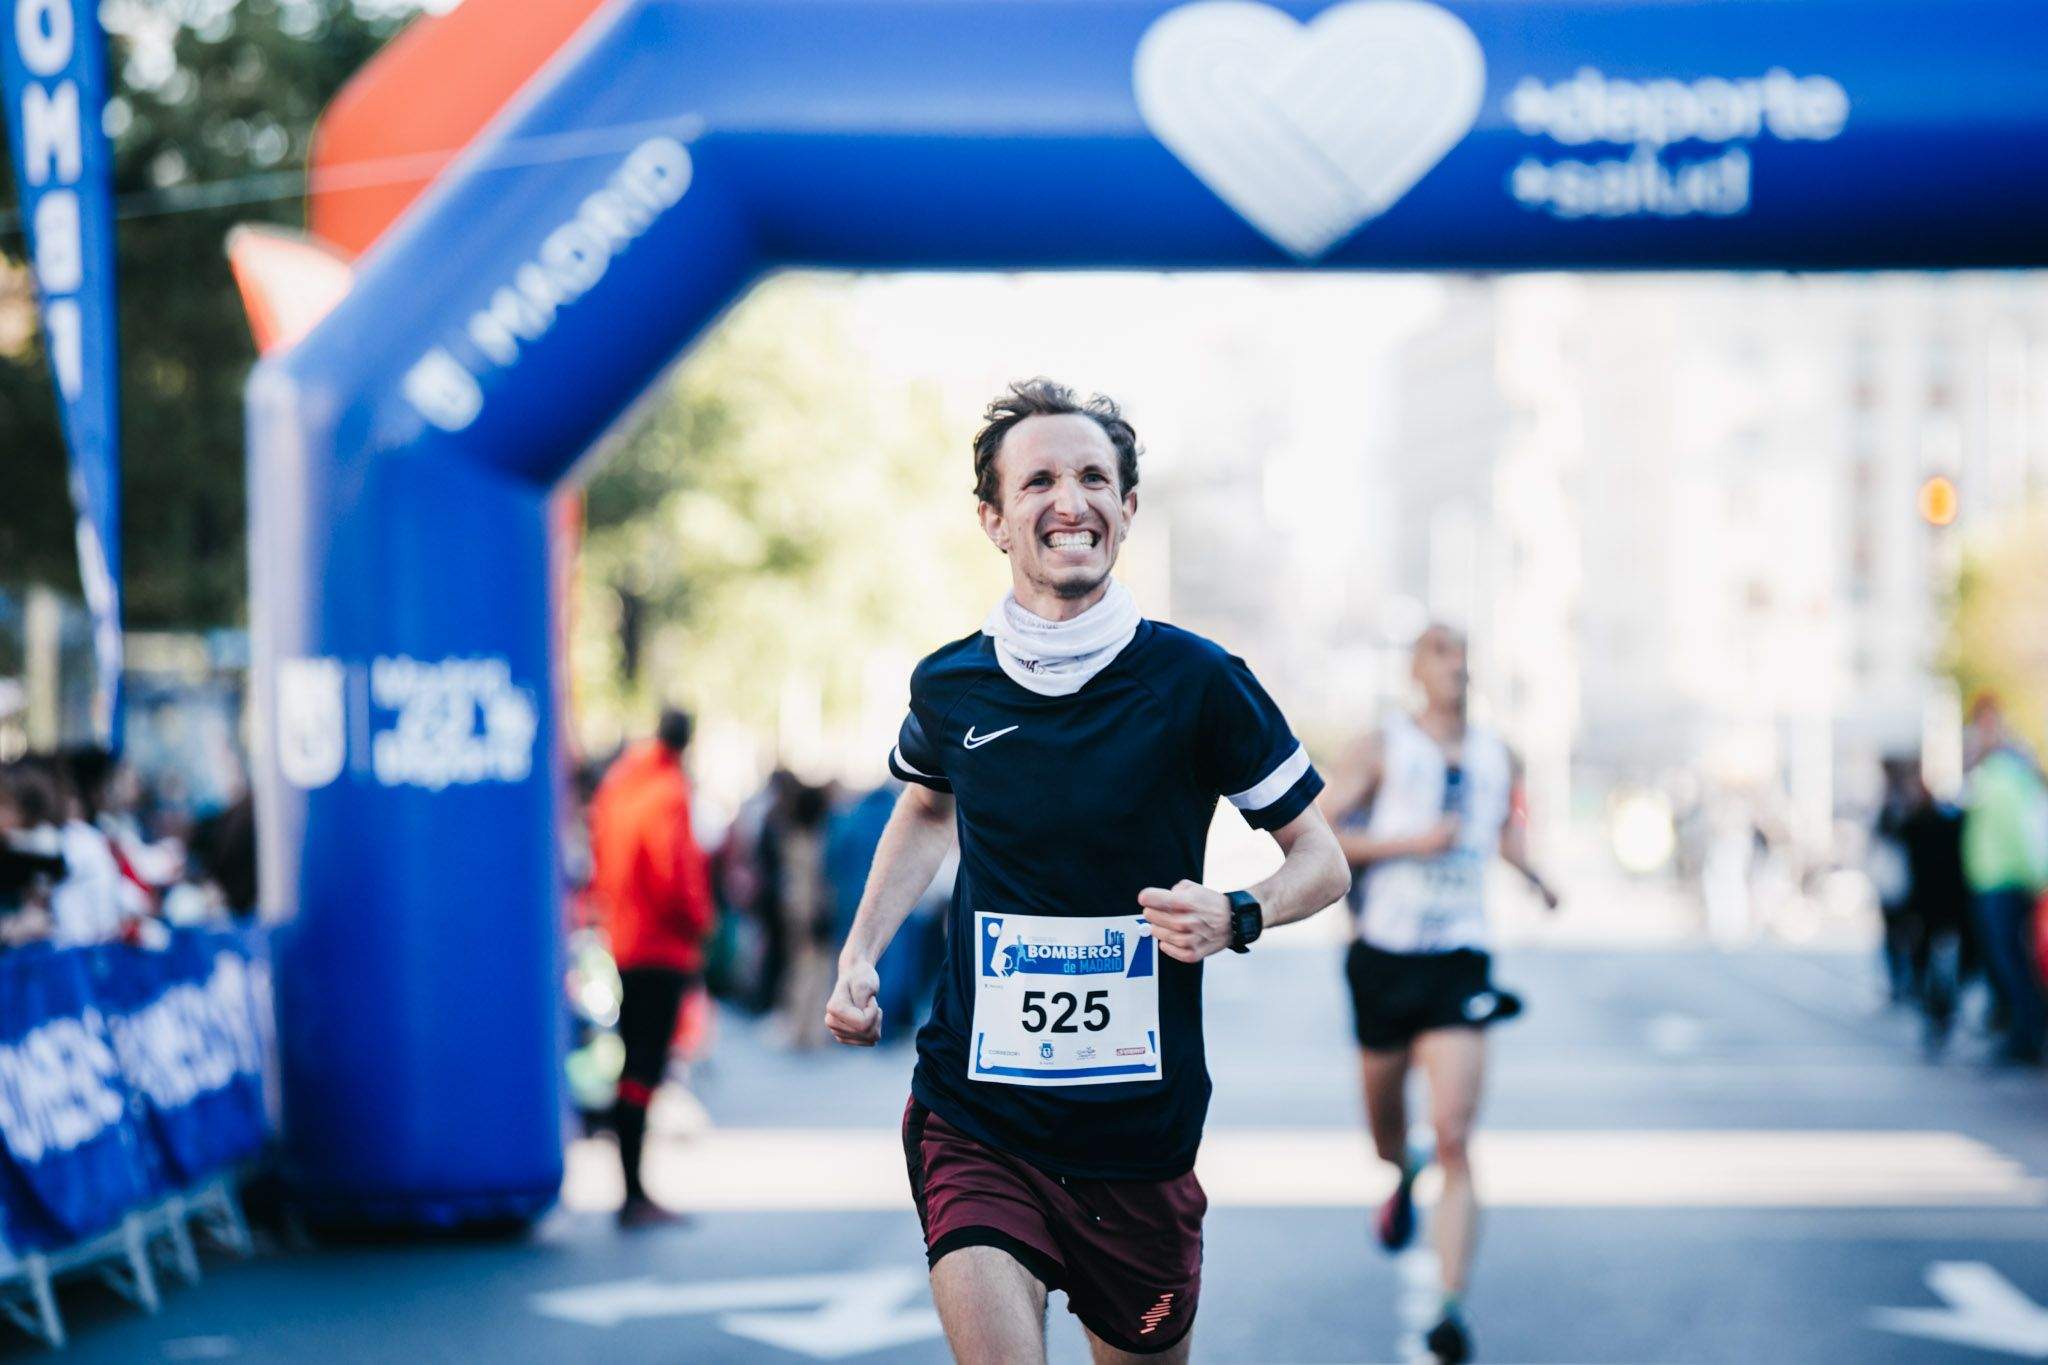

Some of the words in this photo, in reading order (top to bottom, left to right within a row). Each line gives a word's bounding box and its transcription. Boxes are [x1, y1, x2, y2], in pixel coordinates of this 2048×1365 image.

[1028, 944, 1122, 960] BOMBEROS
[1063, 959, 1076, 973] de
[1080, 958, 1122, 973] MADRID
[1021, 990, 1111, 1034] 525
